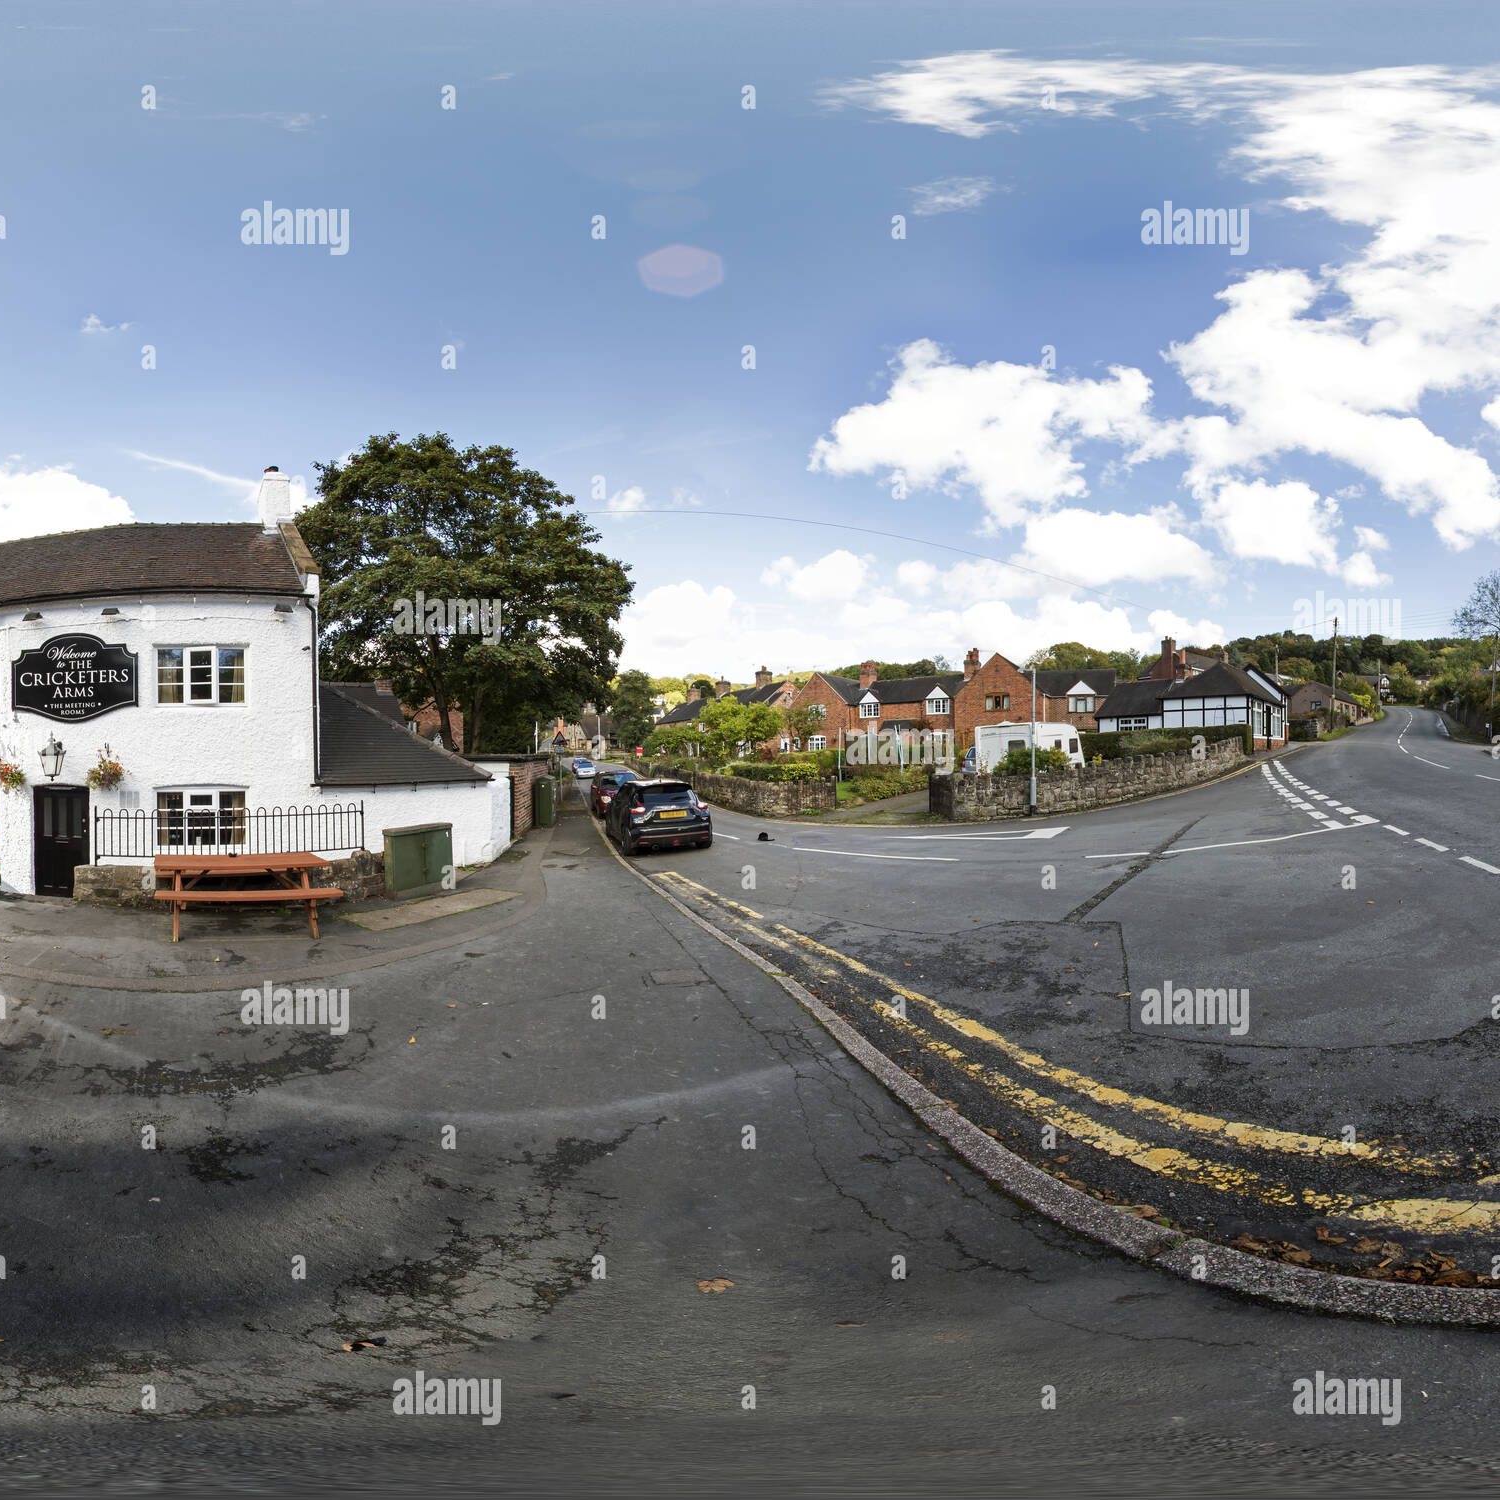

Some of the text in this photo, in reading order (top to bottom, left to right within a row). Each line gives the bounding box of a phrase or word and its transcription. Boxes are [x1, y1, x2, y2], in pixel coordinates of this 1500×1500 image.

[47, 644, 97, 661] Welcome
[56, 660, 92, 669] to THE
[20, 669, 129, 686] CRICKETERS
[52, 686, 94, 698] ARMS
